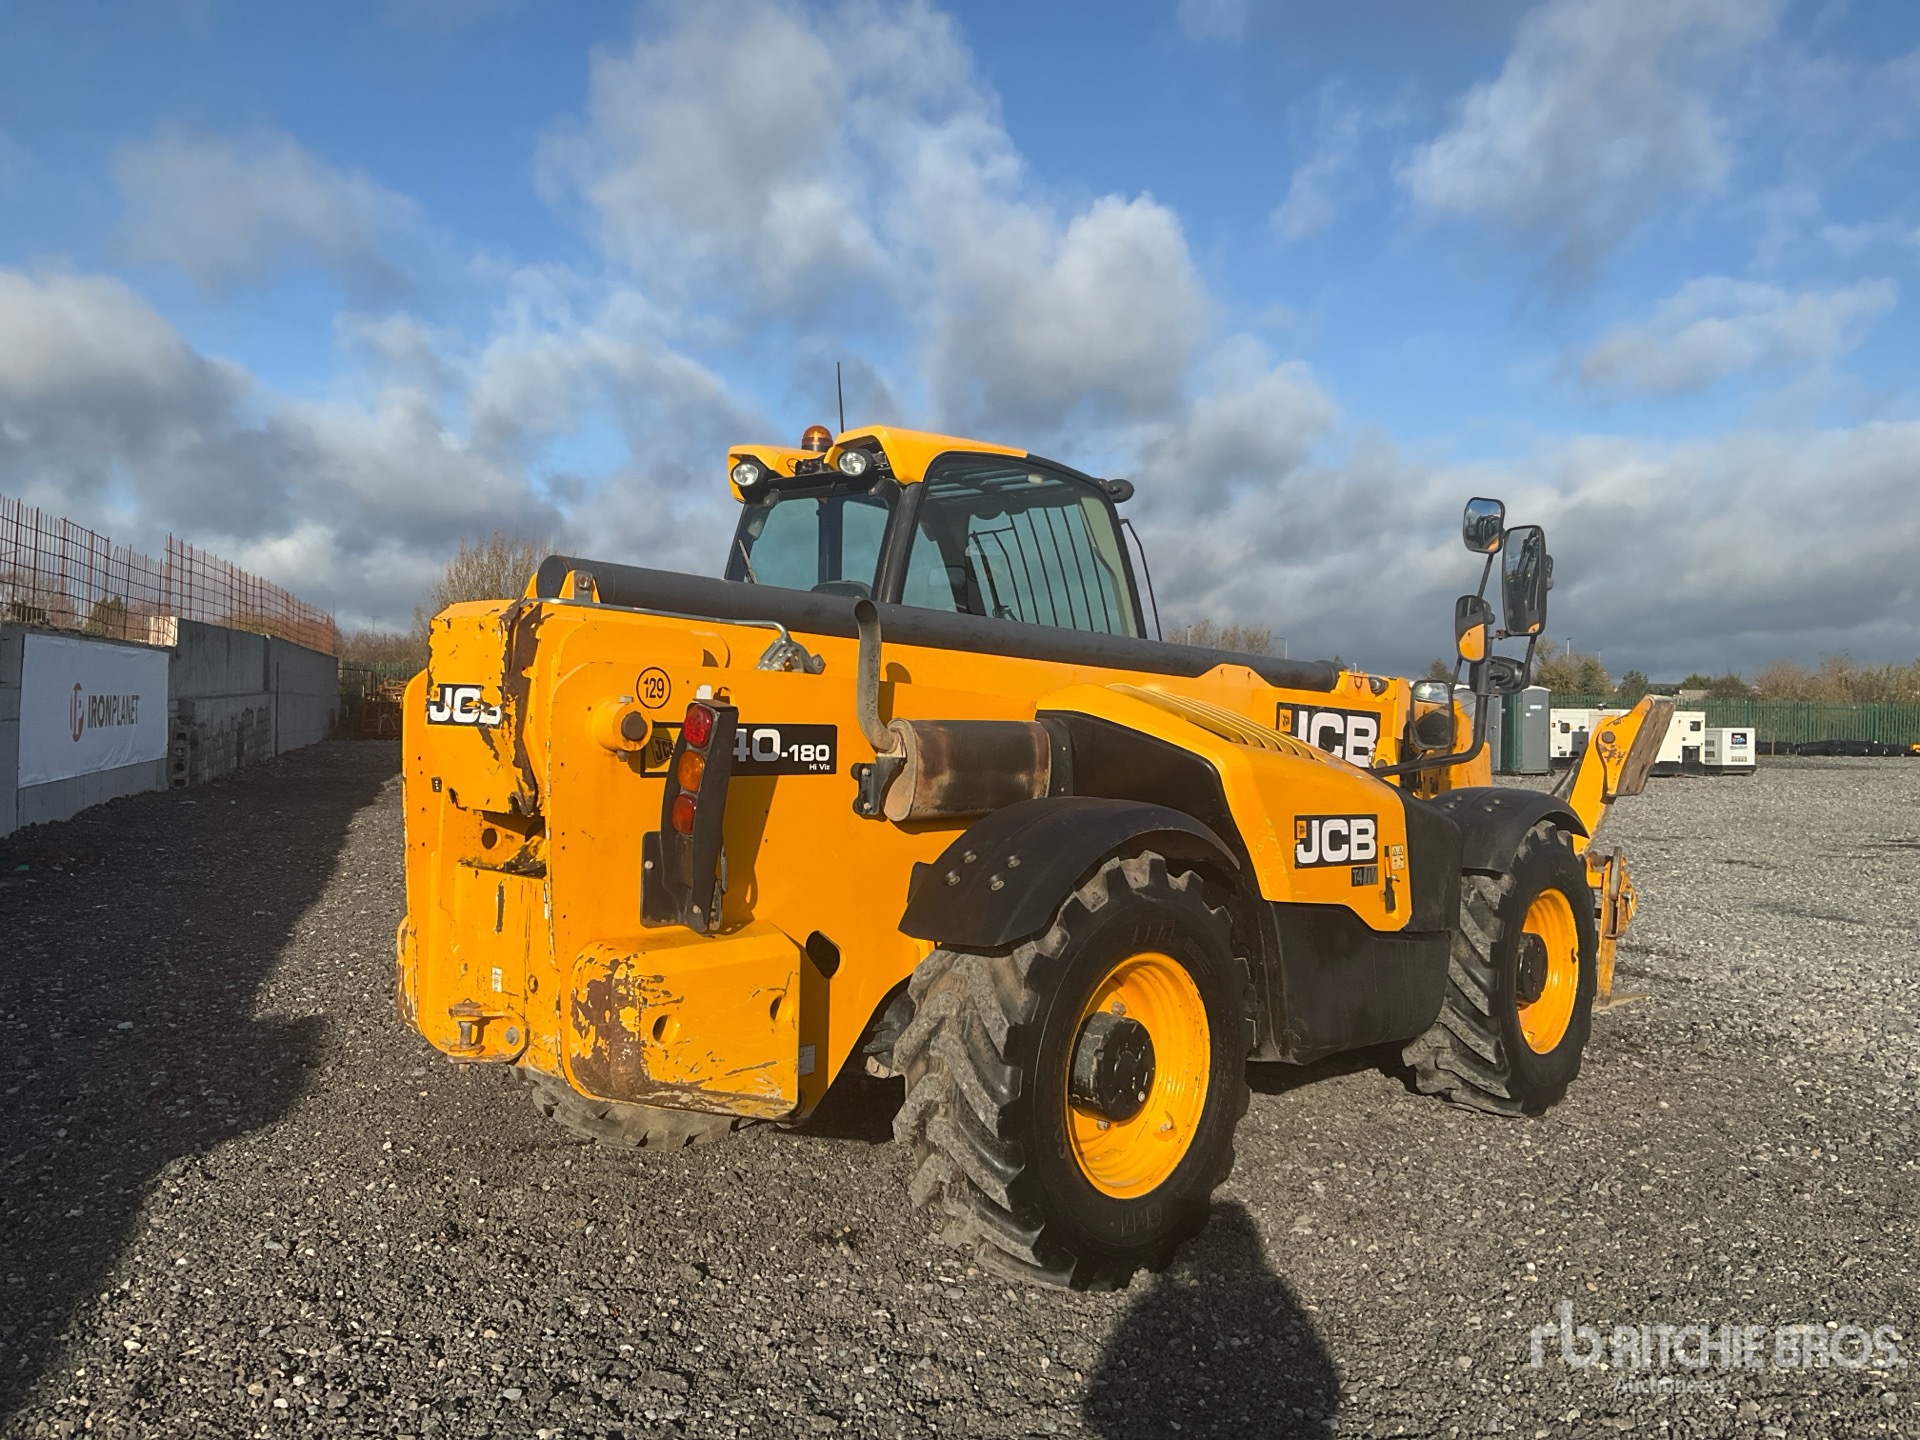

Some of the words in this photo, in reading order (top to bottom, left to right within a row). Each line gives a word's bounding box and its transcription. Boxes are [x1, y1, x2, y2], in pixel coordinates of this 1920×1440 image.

[643, 677, 665, 699] 129
[87, 694, 140, 729] IRONPLANET
[809, 763, 817, 771] Hi
[818, 763, 831, 771] Viz
[1296, 818, 1376, 864] JCB
